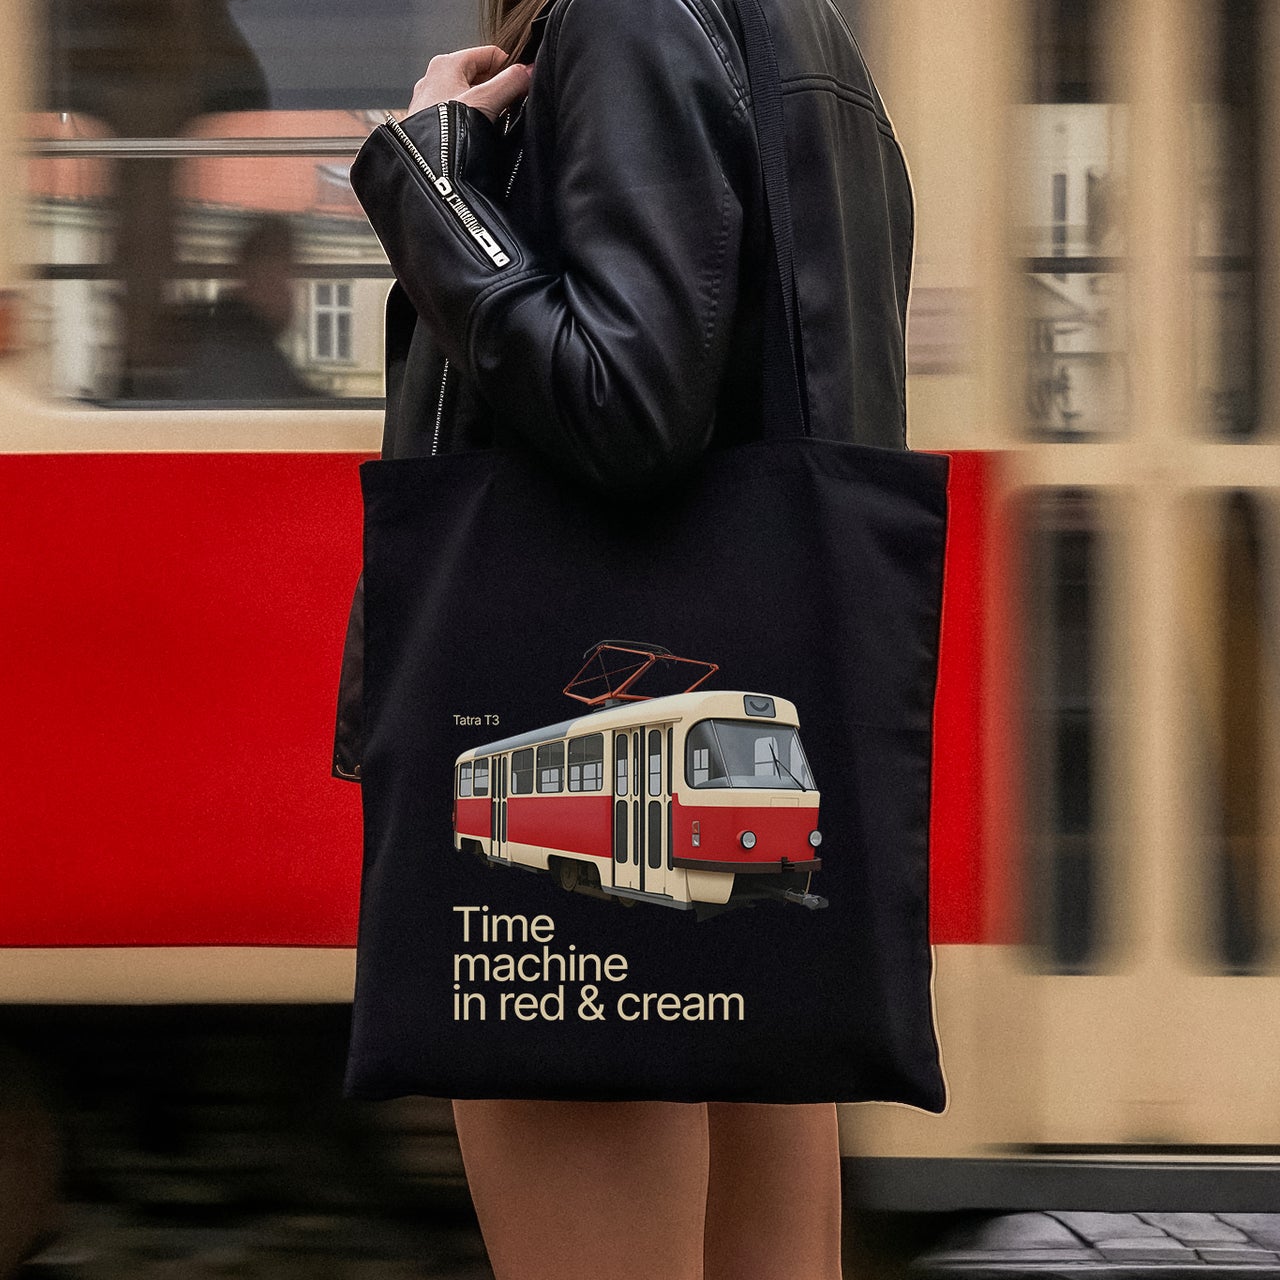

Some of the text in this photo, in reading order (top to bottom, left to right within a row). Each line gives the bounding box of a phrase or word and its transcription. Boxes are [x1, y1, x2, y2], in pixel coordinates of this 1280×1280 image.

[453, 714, 500, 726] Tatra T3
[453, 905, 555, 943] Time
[453, 945, 628, 982] machine
[453, 983, 745, 1021] in red & cream
